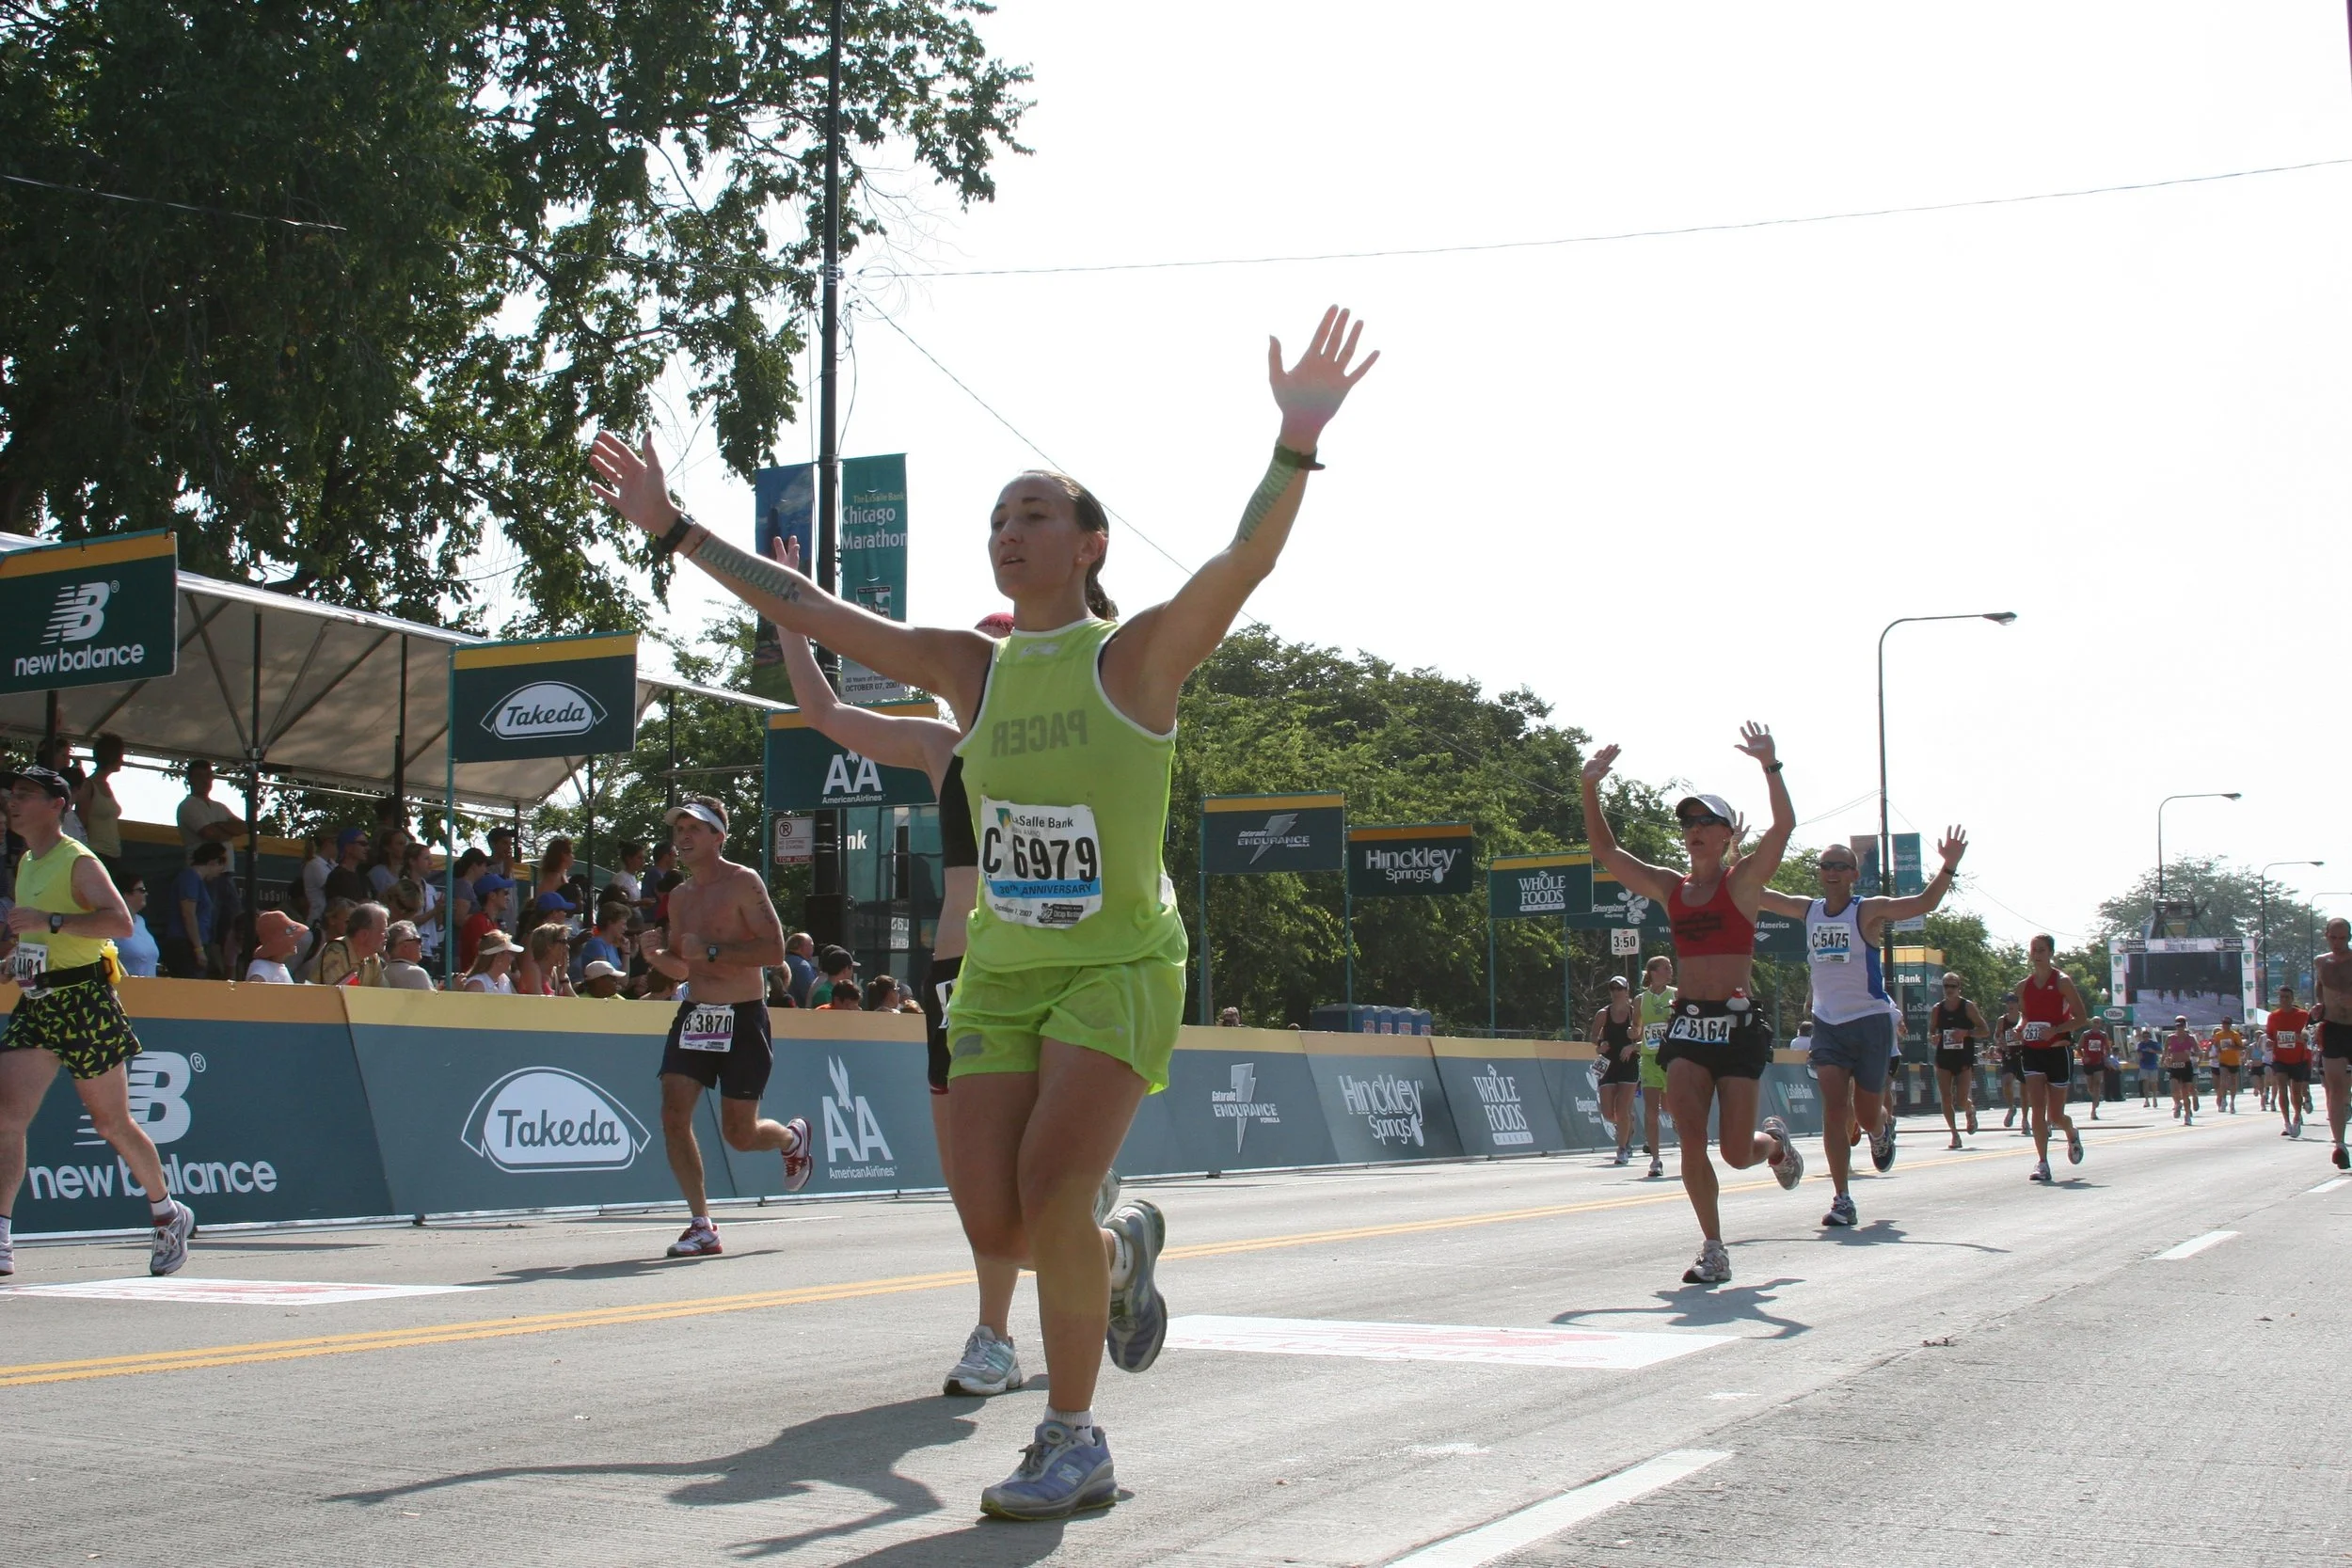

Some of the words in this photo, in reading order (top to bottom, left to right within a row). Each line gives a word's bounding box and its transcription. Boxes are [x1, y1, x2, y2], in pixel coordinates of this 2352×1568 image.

[843, 505, 896, 526] Chicago
[843, 529, 909, 549] Marathon
[15, 654, 56, 677] new
[59, 643, 145, 673] balance
[846, 683, 873, 692] OCTOBER
[506, 702, 585, 727] Takeda
[1010, 813, 1045, 828] LaSalle
[1048, 816, 1073, 829] Bank
[1237, 835, 1310, 847] ENDURANCE
[982, 827, 1002, 874] C
[1012, 833, 1098, 883] 6979
[1366, 847, 1456, 873] Hinckley
[1386, 868, 1432, 884] Springs
[1518, 871, 1566, 892] WHOLE
[1022, 884, 1092, 896] ANNIVERSARY
[1521, 889, 1564, 905] FOODS
[1592, 903, 1626, 913] Energizer
[1760, 921, 1789, 929] America
[1613, 935, 1636, 948] 3:50
[1812, 932, 1819, 948] C
[1820, 932, 1850, 948] 5475
[1898, 974, 1921, 984] Bank
[695, 1014, 732, 1033] 3870
[1675, 1018, 1686, 1036] C
[1688, 1019, 1727, 1041] 6164
[1471, 1064, 1521, 1103] WHOLE
[1212, 1103, 1279, 1117] ENDURANCE
[1338, 1074, 1423, 1127] Hinckley
[1484, 1103, 1529, 1132] FOODS
[498, 1108, 621, 1148] Takeda
[1368, 1115, 1412, 1146] Springs
[28, 1165, 114, 1199] new
[117, 1153, 278, 1197] blance
[828, 1165, 896, 1180] AmericanAirlines
